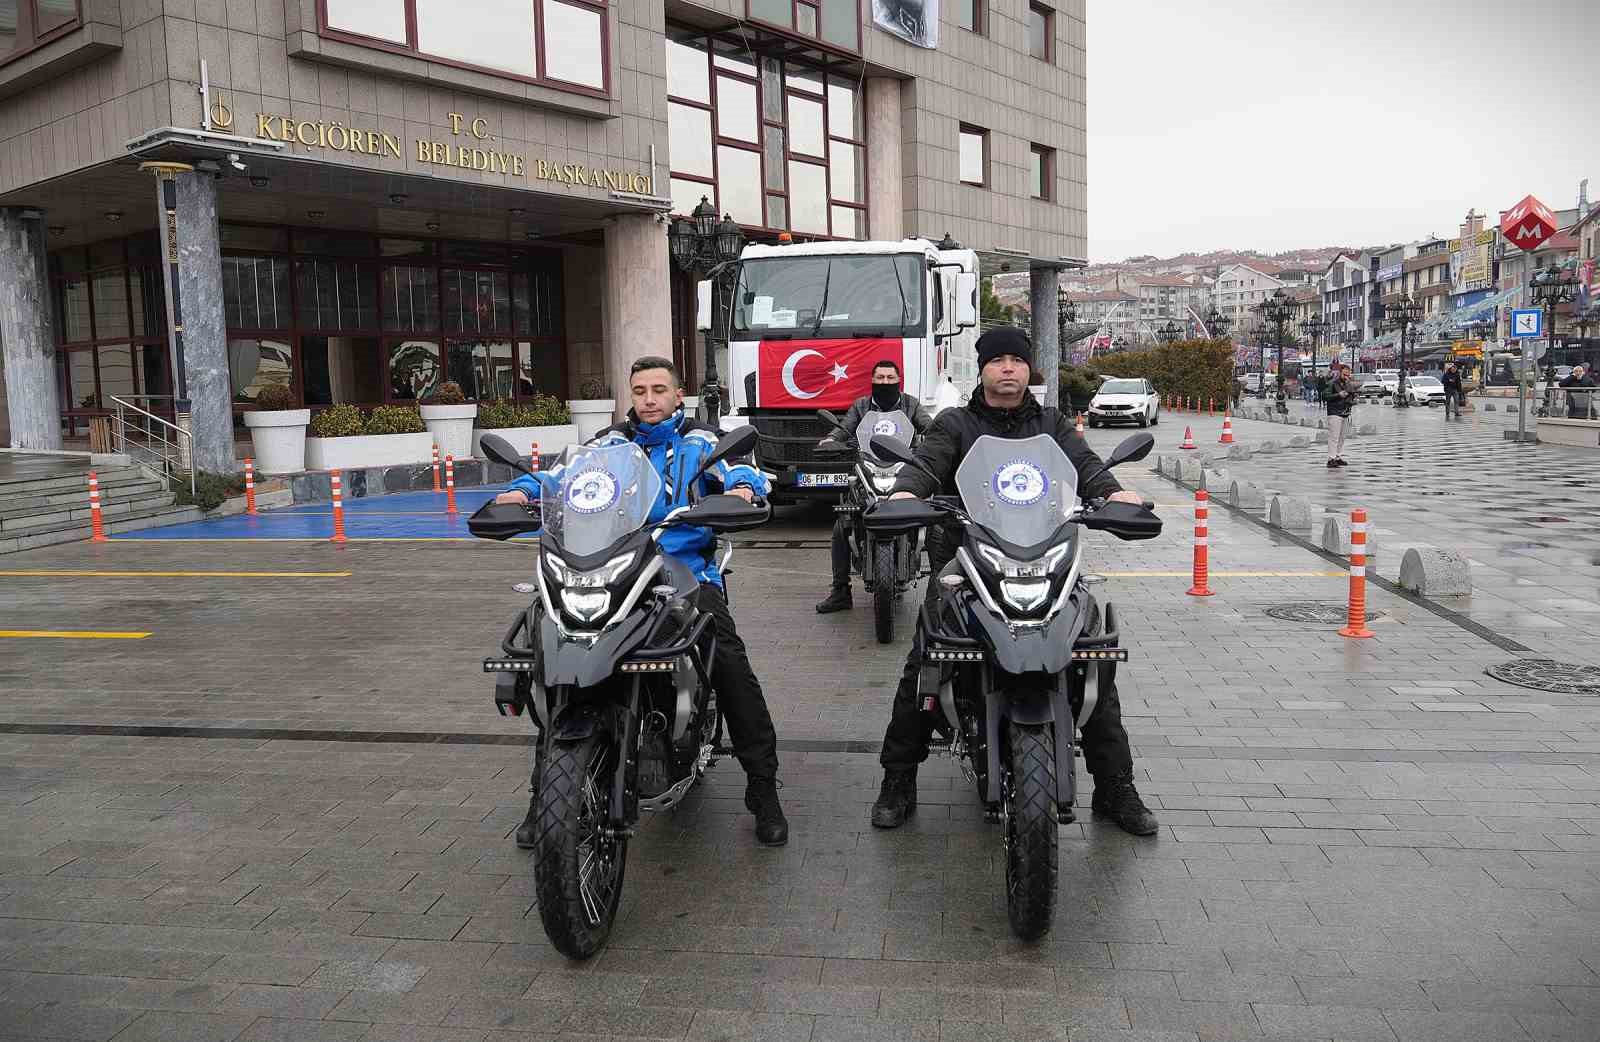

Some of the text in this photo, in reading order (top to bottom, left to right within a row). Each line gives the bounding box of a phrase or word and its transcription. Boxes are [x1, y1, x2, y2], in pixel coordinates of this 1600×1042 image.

[256, 112, 401, 159] KEÇİÖREN
[416, 139, 524, 176] BELEDİYE
[1515, 222, 1543, 239] M
